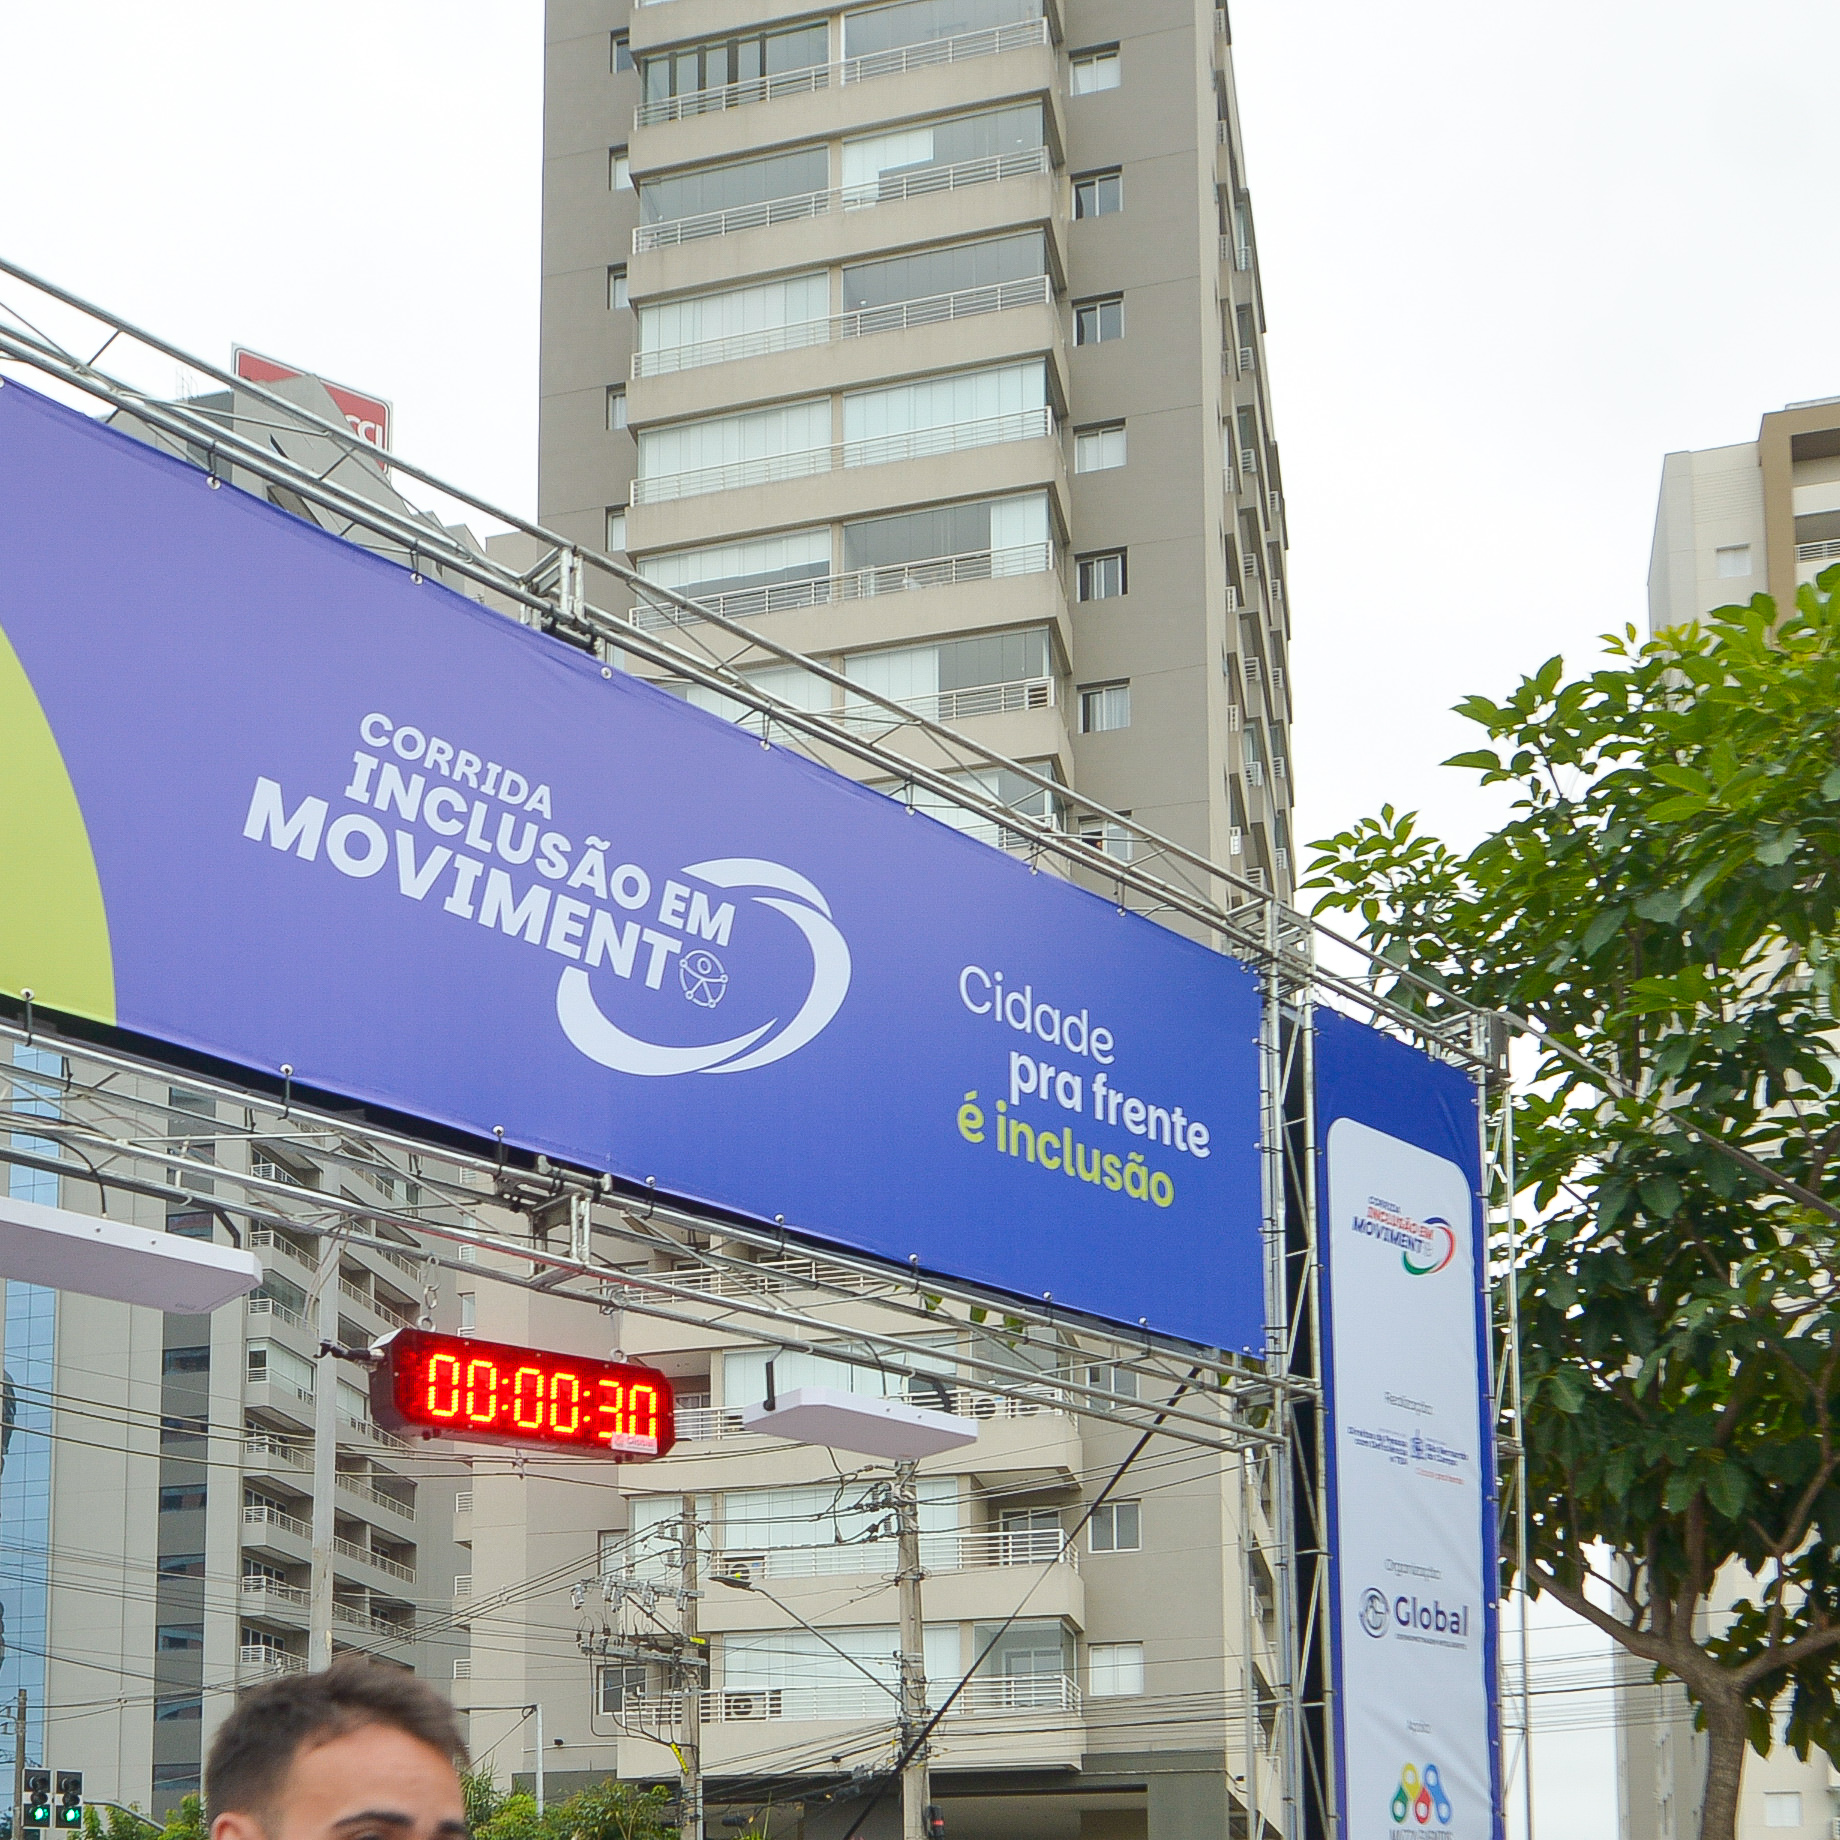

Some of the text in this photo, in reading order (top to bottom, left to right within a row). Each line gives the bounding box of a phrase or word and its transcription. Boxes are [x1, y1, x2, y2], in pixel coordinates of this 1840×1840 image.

[360, 712, 553, 820] CORRIDA
[345, 750, 737, 948] INCLUSÃO EM
[960, 965, 1115, 1065] Cidade
[957, 1090, 1175, 1208] é inclusão
[1010, 1050, 1212, 1159] pra frente
[428, 1353, 657, 1439] 00:00:30
[1394, 1594, 1469, 1638] Global
